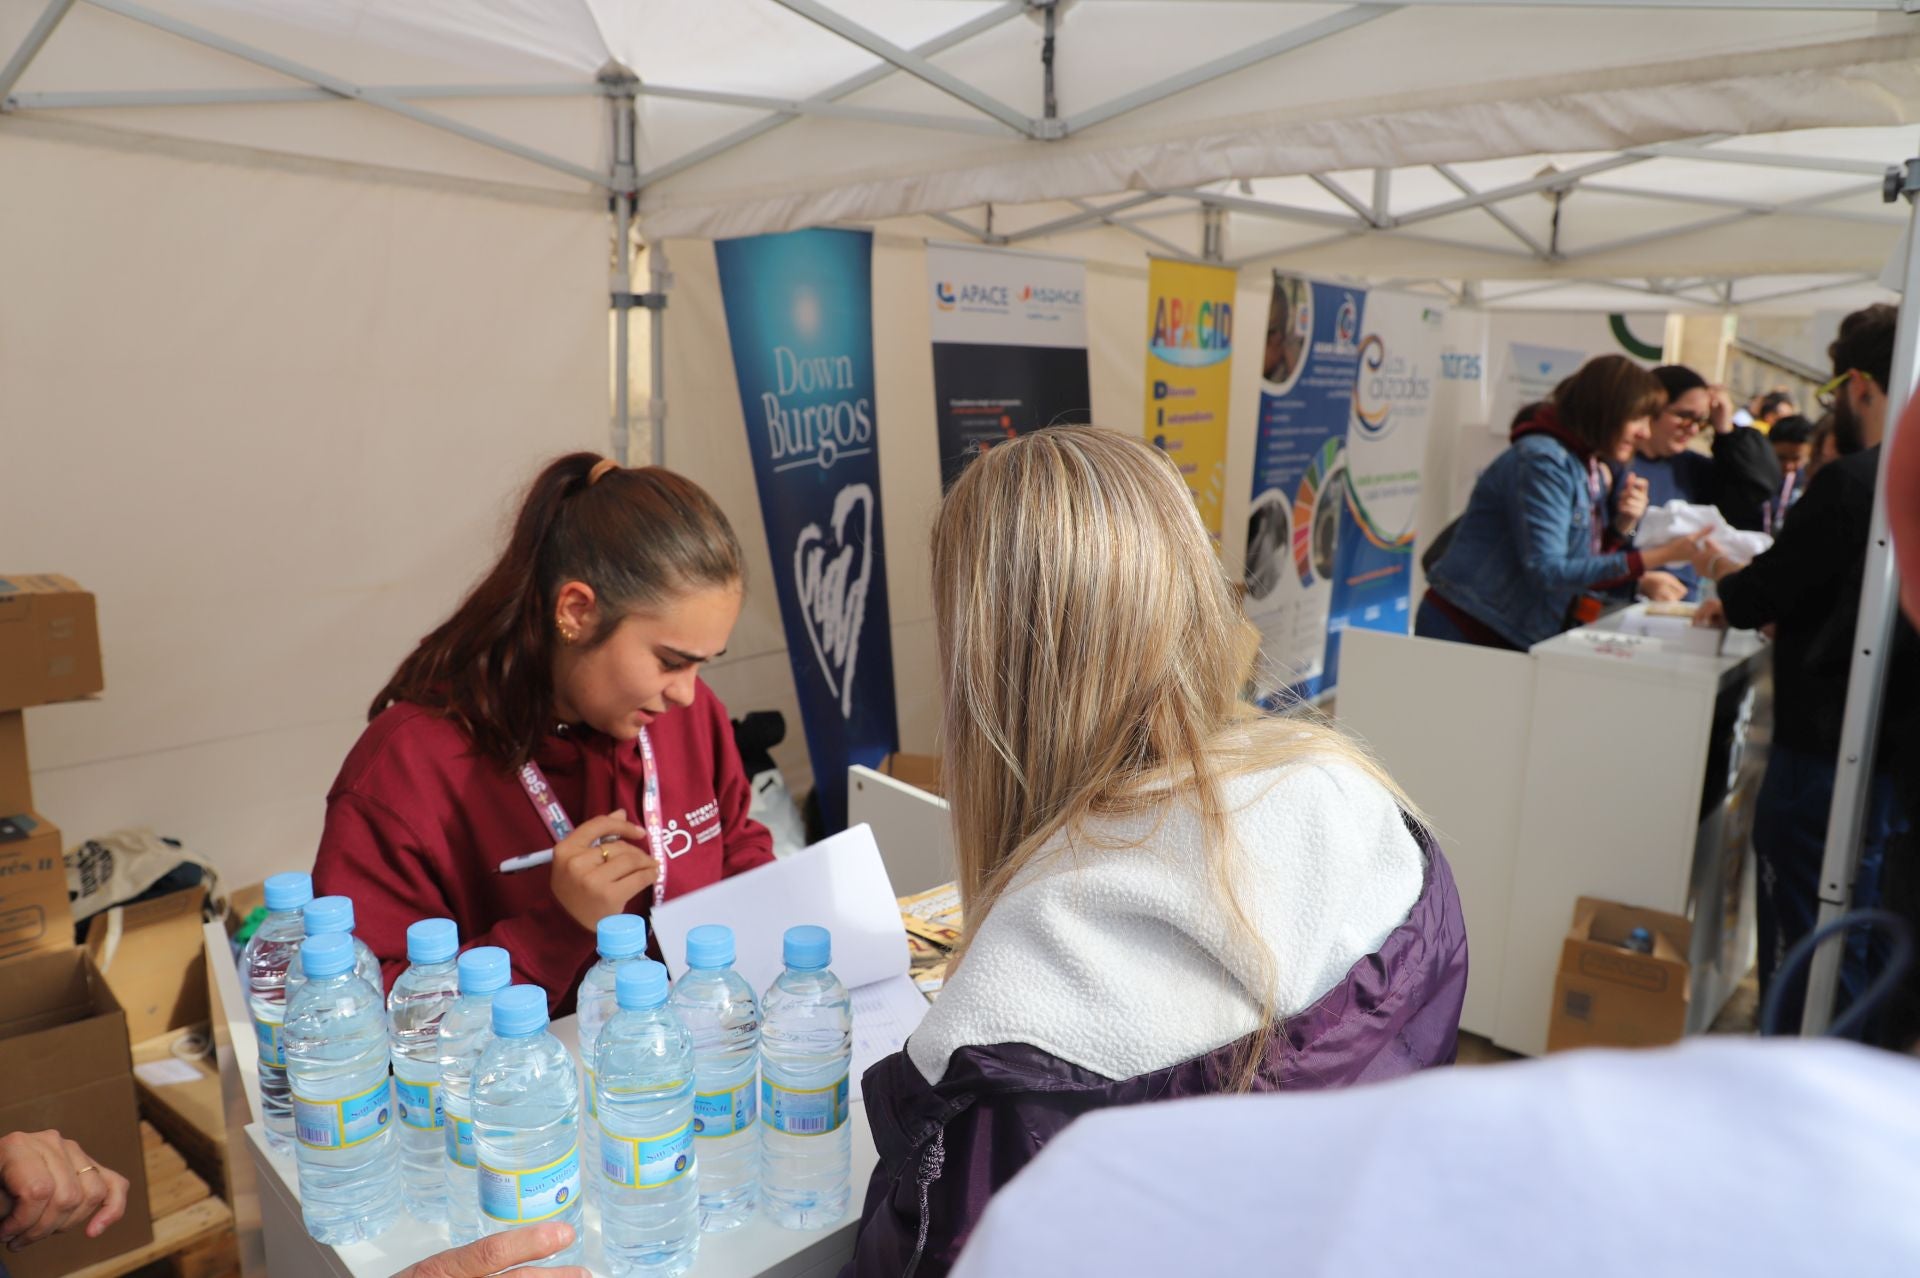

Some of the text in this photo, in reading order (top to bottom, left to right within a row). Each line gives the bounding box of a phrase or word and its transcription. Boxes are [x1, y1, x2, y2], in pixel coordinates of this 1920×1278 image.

[960, 284, 1010, 307] APACE
[774, 345, 854, 396] Down
[762, 391, 872, 469] Burgos
